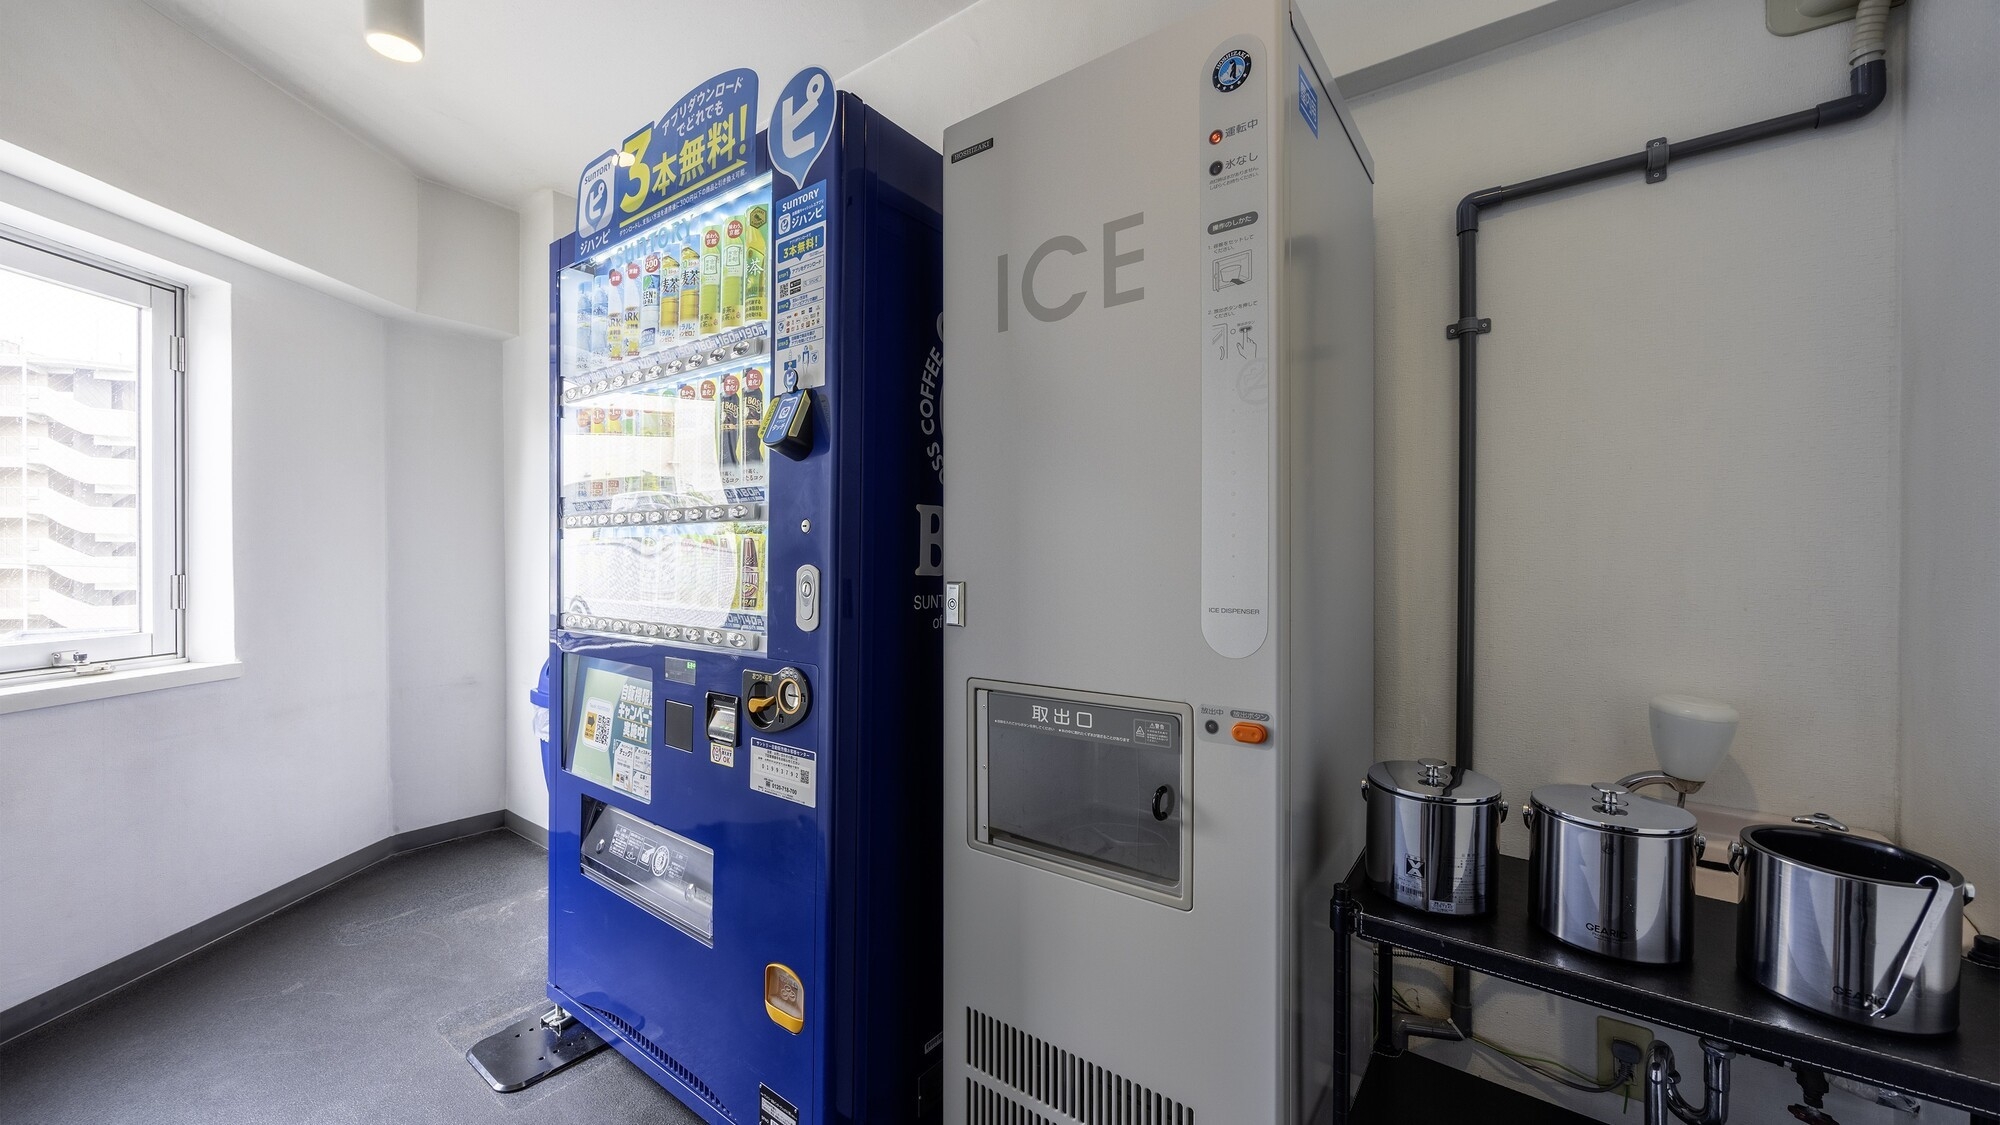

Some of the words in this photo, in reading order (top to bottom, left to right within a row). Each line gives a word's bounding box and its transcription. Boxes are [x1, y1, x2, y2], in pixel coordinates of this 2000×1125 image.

[661, 76, 744, 137] アプリダウンロード
[676, 100, 724, 137] でどれでも
[782, 73, 826, 159] ピ
[1224, 118, 1259, 139] 運転中
[620, 104, 748, 213] 3本無料!
[1225, 152, 1259, 170] 氷なし
[584, 162, 613, 186] SUNTORY
[782, 188, 820, 212] SUNTORY
[791, 205, 824, 229] ジハンピ
[1212, 215, 1253, 232] 操作のしかた
[579, 228, 613, 255] ジハンピ
[783, 235, 818, 259] 3本無料!
[997, 211, 1145, 334] ICE
[662, 278, 679, 293] 麦茶
[1031, 704, 1093, 729] 取出口
